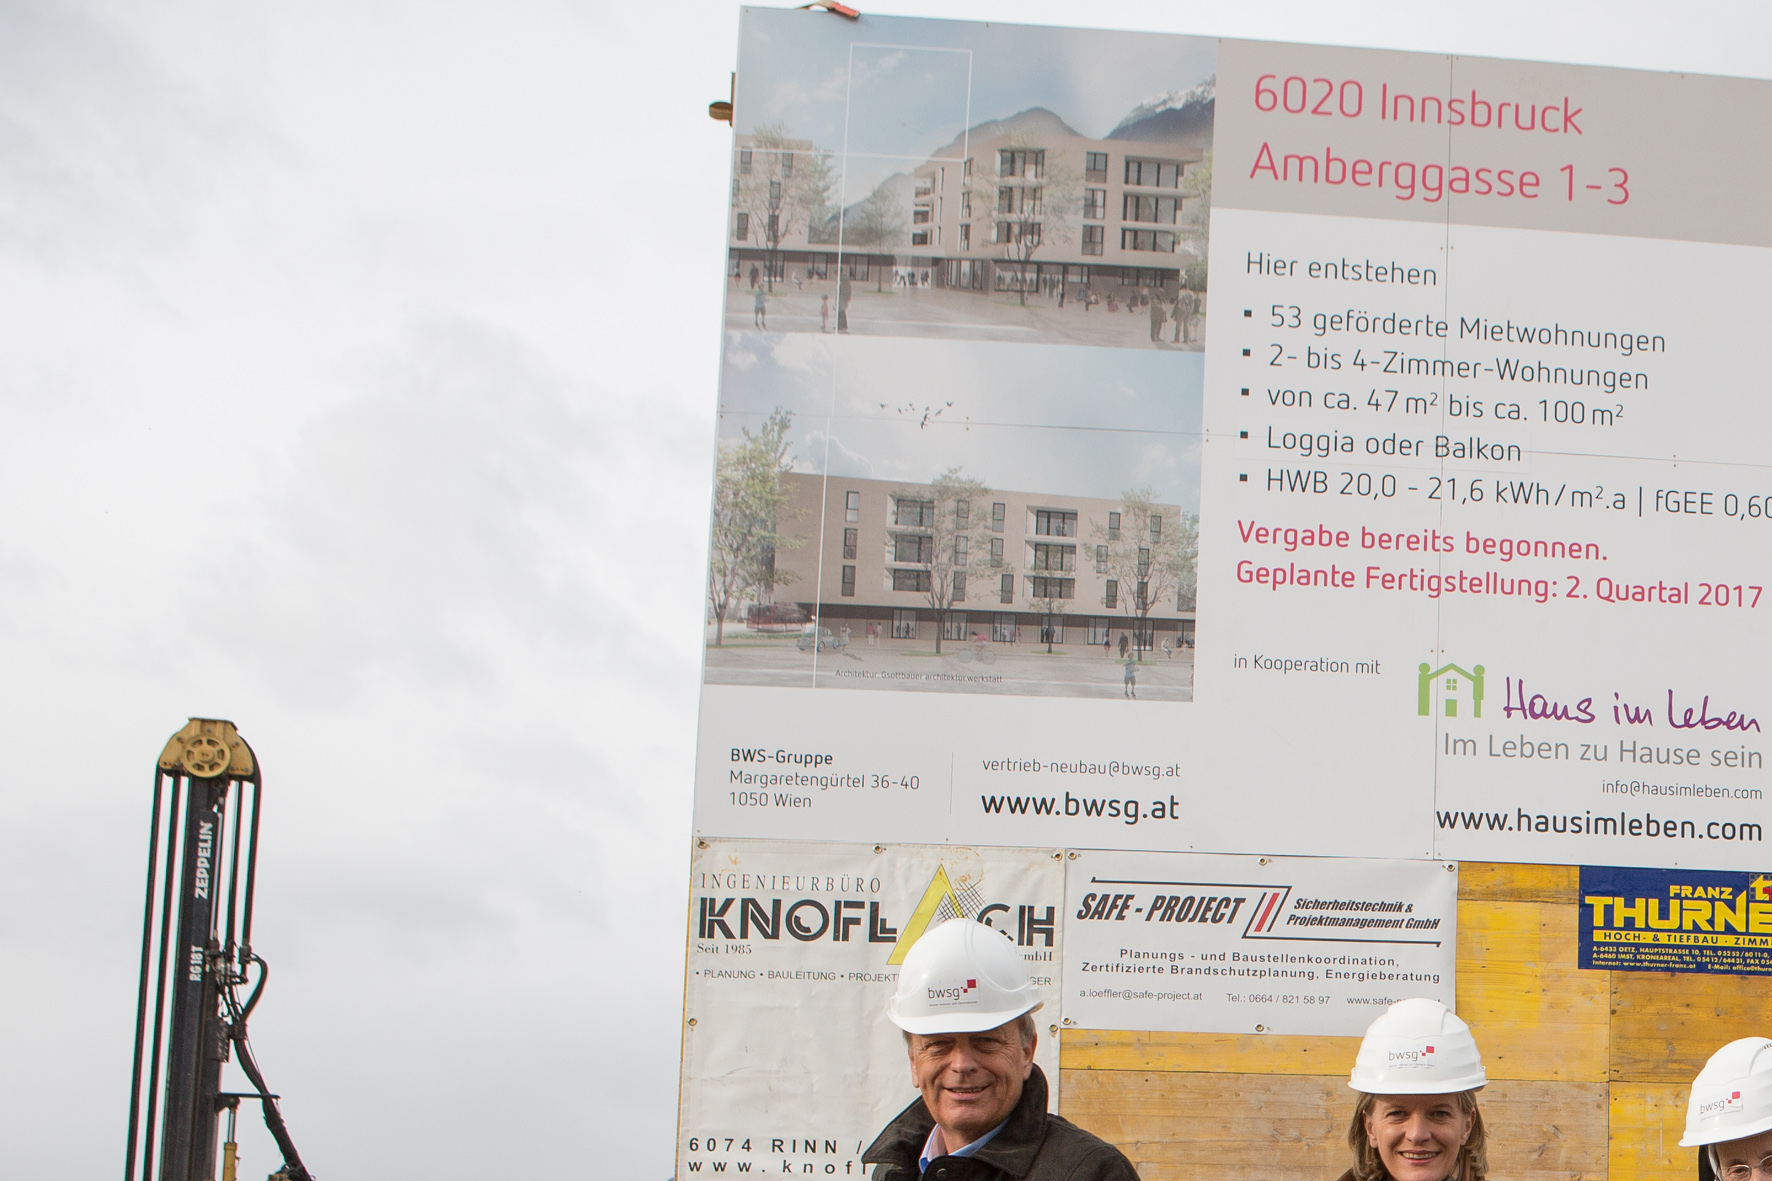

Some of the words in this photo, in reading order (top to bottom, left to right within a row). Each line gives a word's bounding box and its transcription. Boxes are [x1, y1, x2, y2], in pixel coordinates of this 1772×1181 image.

[1254, 75, 1363, 117] 6020
[1381, 83, 1583, 135] Innsbruck
[1250, 142, 1540, 202] Amberggasse
[1559, 164, 1630, 205] 1-3
[1246, 252, 1298, 277] Hier
[1308, 258, 1437, 286] entstehen
[1270, 305, 1301, 328] 53
[1313, 309, 1448, 338] geförderte
[1459, 316, 1665, 356] Mietwohnungen
[1269, 344, 1297, 367] 2-
[1306, 346, 1341, 370] bis
[1353, 349, 1648, 393] 4-Zimmer-Wohnungen
[1267, 388, 1313, 408] von
[1323, 391, 1359, 411] ca.
[1449, 394, 1483, 418] bis
[1494, 401, 1528, 422] ca.
[1267, 426, 1355, 457] Loggia
[1366, 433, 1424, 458] oder
[1435, 435, 1521, 462] Balkon
[1266, 469, 1328, 494] HWB
[1339, 473, 1397, 501] 20,0
[1427, 477, 1484, 505] 21,6
[1655, 489, 1713, 516] fGEE
[1237, 520, 1349, 552] Vergabe
[1361, 526, 1455, 554] bereits
[1466, 531, 1608, 562] begonnen.
[1236, 560, 1355, 592] Geplante
[1366, 566, 1558, 603] Fertigstellung:
[1565, 575, 1589, 599] 2.
[1596, 578, 1688, 605] Quartal
[1698, 583, 1763, 609] 2017
[835, 670, 879, 679] Architektur:
[1234, 654, 1248, 668] in
[1253, 655, 1349, 675] Kooperation
[1356, 660, 1380, 675] mit
[1503, 676, 1596, 724] Haus
[1614, 692, 1653, 728] im
[731, 748, 833, 769] BWS-Gruppe
[1444, 733, 1477, 757] Im
[1488, 735, 1569, 761] Leben
[1579, 741, 1607, 762] zu
[1619, 741, 1700, 767] Hause
[1710, 745, 1762, 769] sein
[982, 757, 1180, 779] vertrieb-neubau@bwsg.at
[729, 770, 865, 791] Margaretengürtel
[871, 773, 919, 790] 36-40
[1602, 779, 1762, 800] info@hausimleben.com
[729, 791, 768, 808] 1050
[774, 793, 812, 809] Wien
[982, 792, 1179, 825] www.bwsg.at
[1437, 808, 1762, 842] www.hausimleben.com
[195, 820, 213, 900] ZEPPELIN
[701, 873, 881, 893] INGENIEURBÜRO
[1670, 885, 1732, 899] FRANZ
[1077, 893, 1134, 921] SAFE
[1145, 895, 1246, 924] PROJECT
[1294, 898, 1404, 913] Sicherheitstechnik
[1405, 903, 1413, 913] &
[1286, 914, 1403, 930] Projektmanagement
[1405, 918, 1440, 930] GmbH
[697, 943, 718, 954] Seit
[725, 944, 752, 954] 1985
[1604, 932, 1646, 942] HOCH-
[1652, 934, 1661, 943] &
[1667, 934, 1719, 945] TIEFBAU
[1015, 950, 1053, 961] mbH
[1120, 948, 1184, 962] Planungs
[1201, 950, 1226, 961] und
[1232, 951, 1399, 968] Baustellenkoordination,
[1623, 961, 1696, 969] www.thurner-franz.at
[704, 969, 755, 979] PLANUNG
[768, 970, 836, 980] BAULEITUNG
[849, 972, 899, 982] PROJEKT
[1082, 962, 1164, 974] Zertifizierte
[1170, 964, 1320, 981] Brandschutzplanung,
[1326, 969, 1440, 984] Energieberatung
[928, 987, 960, 1000] bwsg
[1079, 988, 1202, 1002] a.loeffler@safe-project.at
[1226, 993, 1246, 1003] Tel.:
[1249, 993, 1273, 1003] 0664
[1282, 995, 1299, 1004] 821
[1303, 995, 1315, 1004] 58
[1318, 996, 1330, 1004] 97
[1388, 1051, 1418, 1062] bwsg
[689, 1138, 752, 1152] 6074
[772, 1139, 836, 1153] RINN
[688, 1160, 866, 1174] www.knofl
